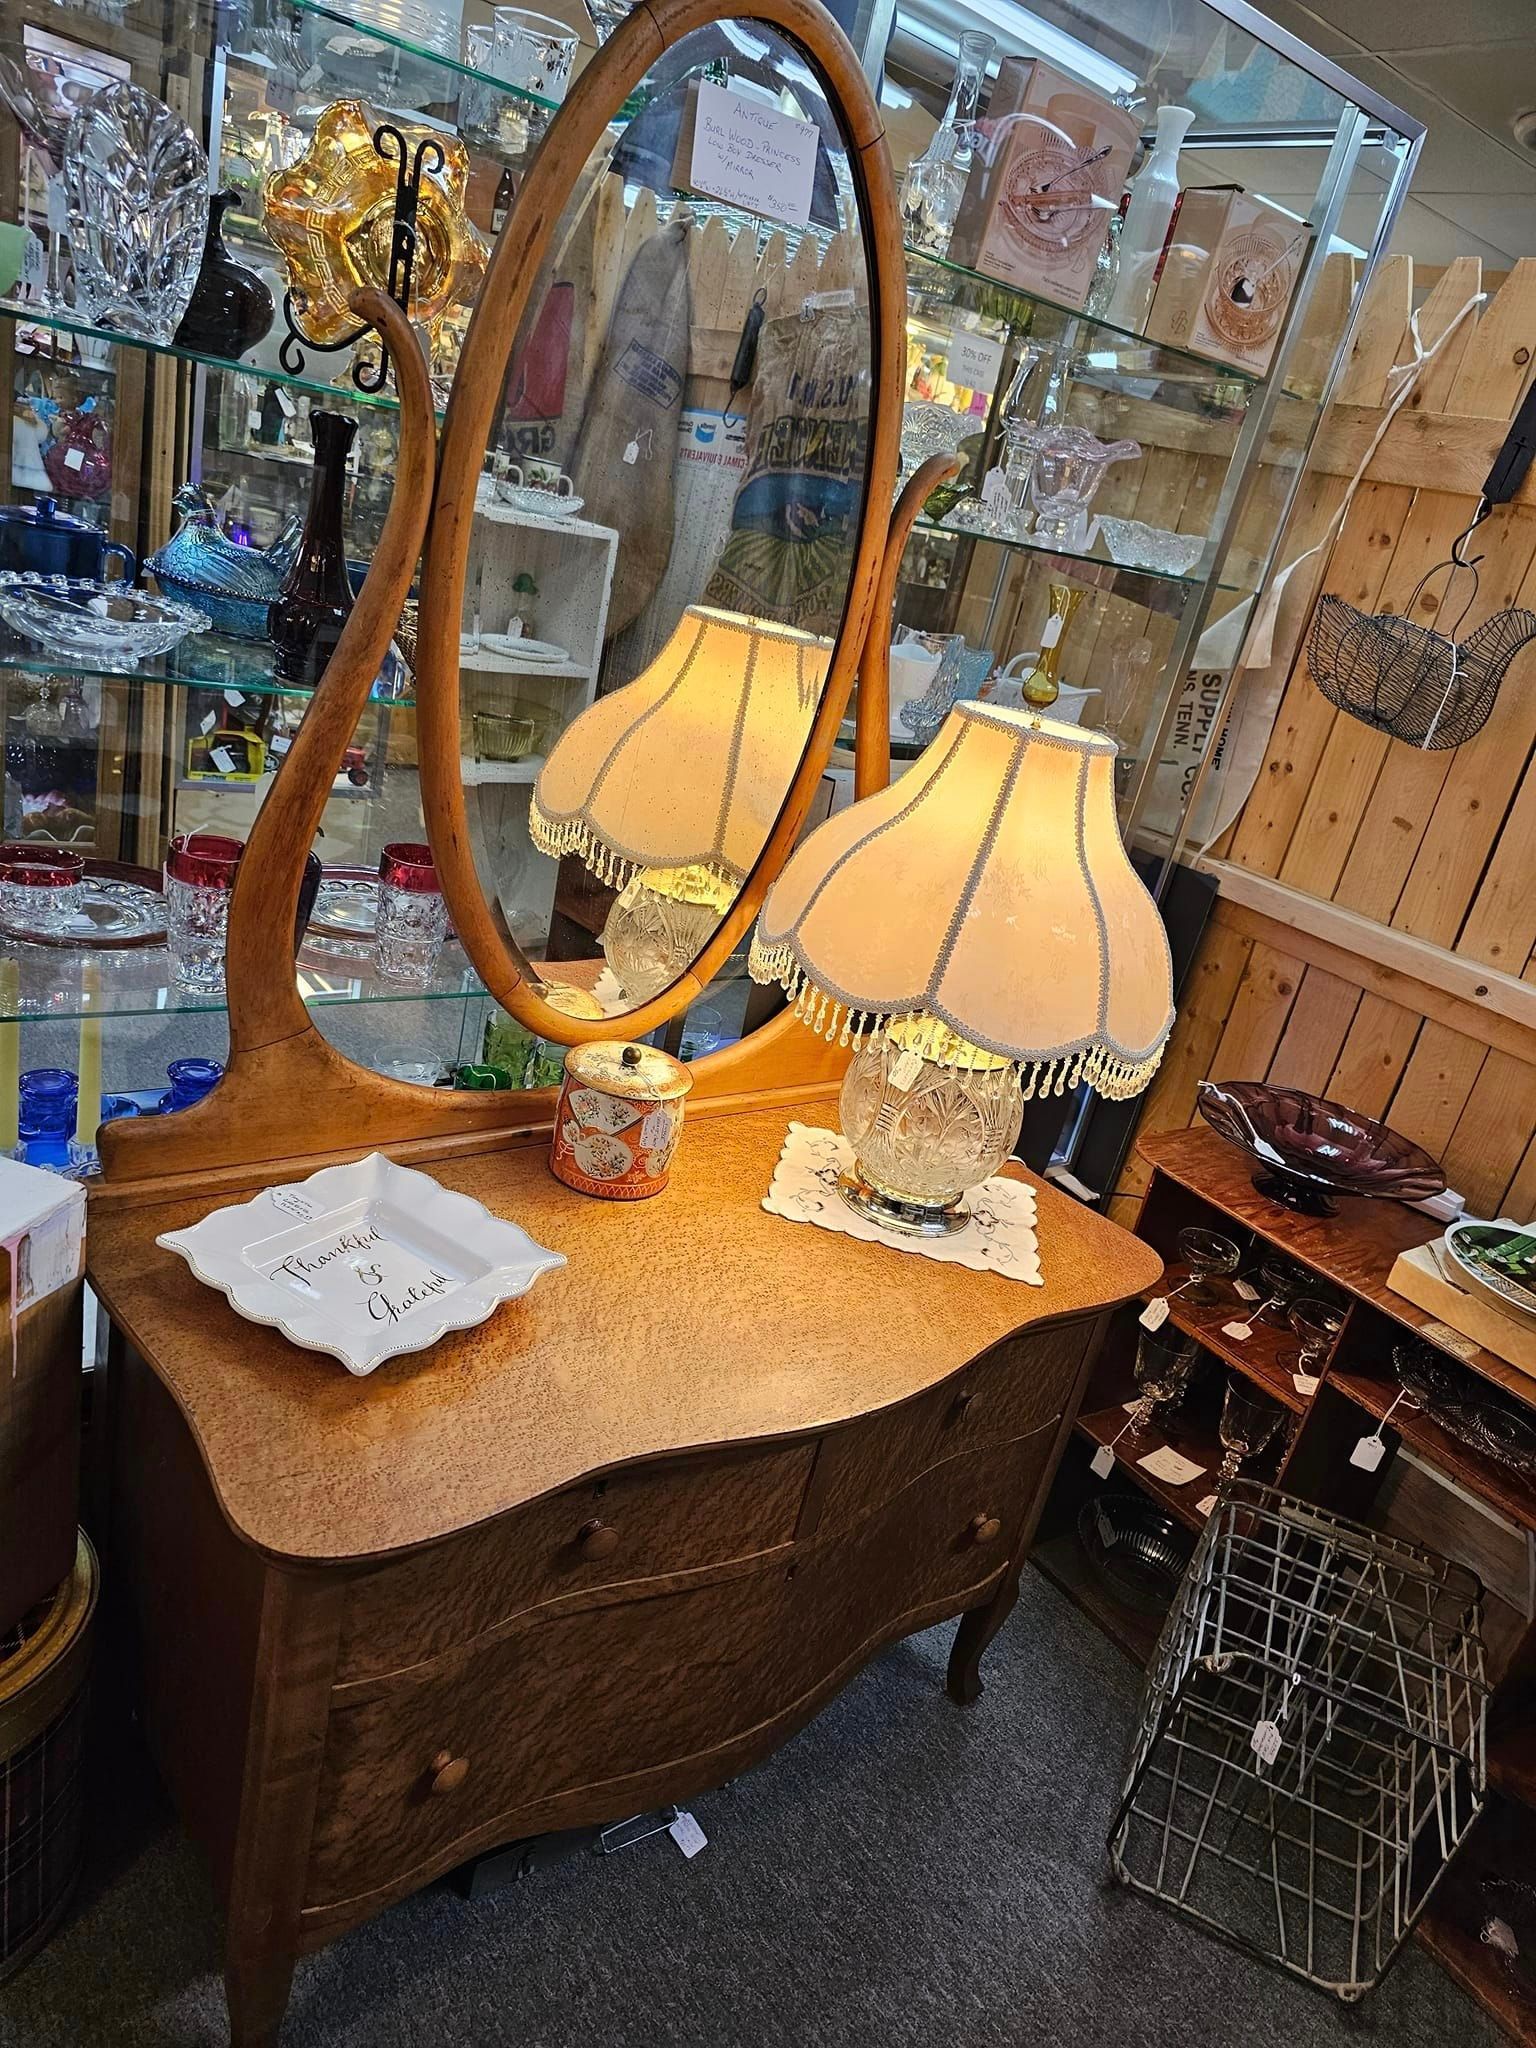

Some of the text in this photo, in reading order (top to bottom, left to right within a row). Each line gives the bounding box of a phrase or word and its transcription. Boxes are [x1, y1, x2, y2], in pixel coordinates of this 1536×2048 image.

[733, 102, 777, 130] ANTIQUE
[704, 117, 801, 166] BURL WOOD PRINCESS
[746, 150, 783, 174] DRESSER
[961, 346, 992, 364] 30% OFF
[1172, 701, 1194, 749] TENN.
[1191, 673, 1222, 754] SUPPLY
[269, 1225, 390, 1287] Thankful
[356, 1263, 389, 1286] &
[355, 1269, 455, 1326] Grateful
